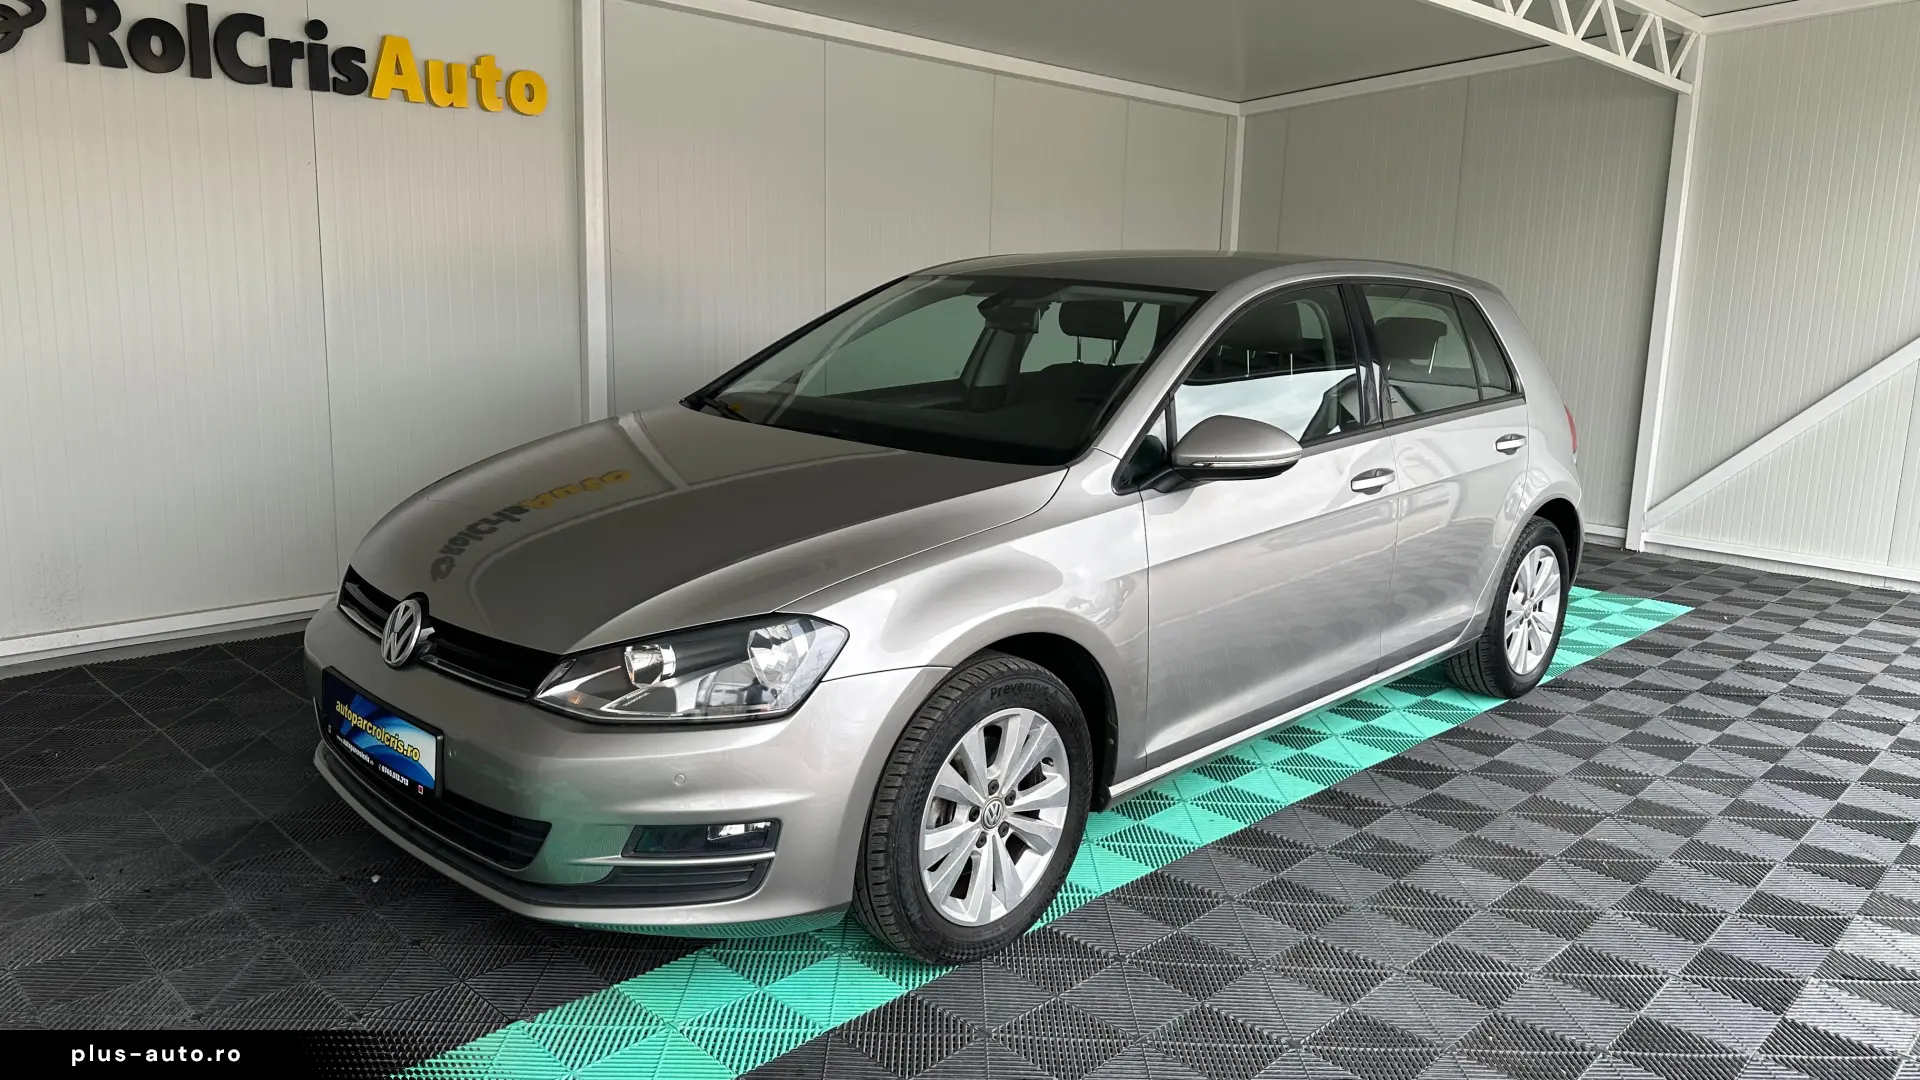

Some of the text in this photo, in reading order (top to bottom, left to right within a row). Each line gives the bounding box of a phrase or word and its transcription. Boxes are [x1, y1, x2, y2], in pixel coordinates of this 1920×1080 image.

[62, 0, 548, 116] RolCrisAuto
[381, 599, 422, 667] VW
[335, 700, 421, 761] autoparcrolcris.ro
[982, 798, 1004, 830] VW
